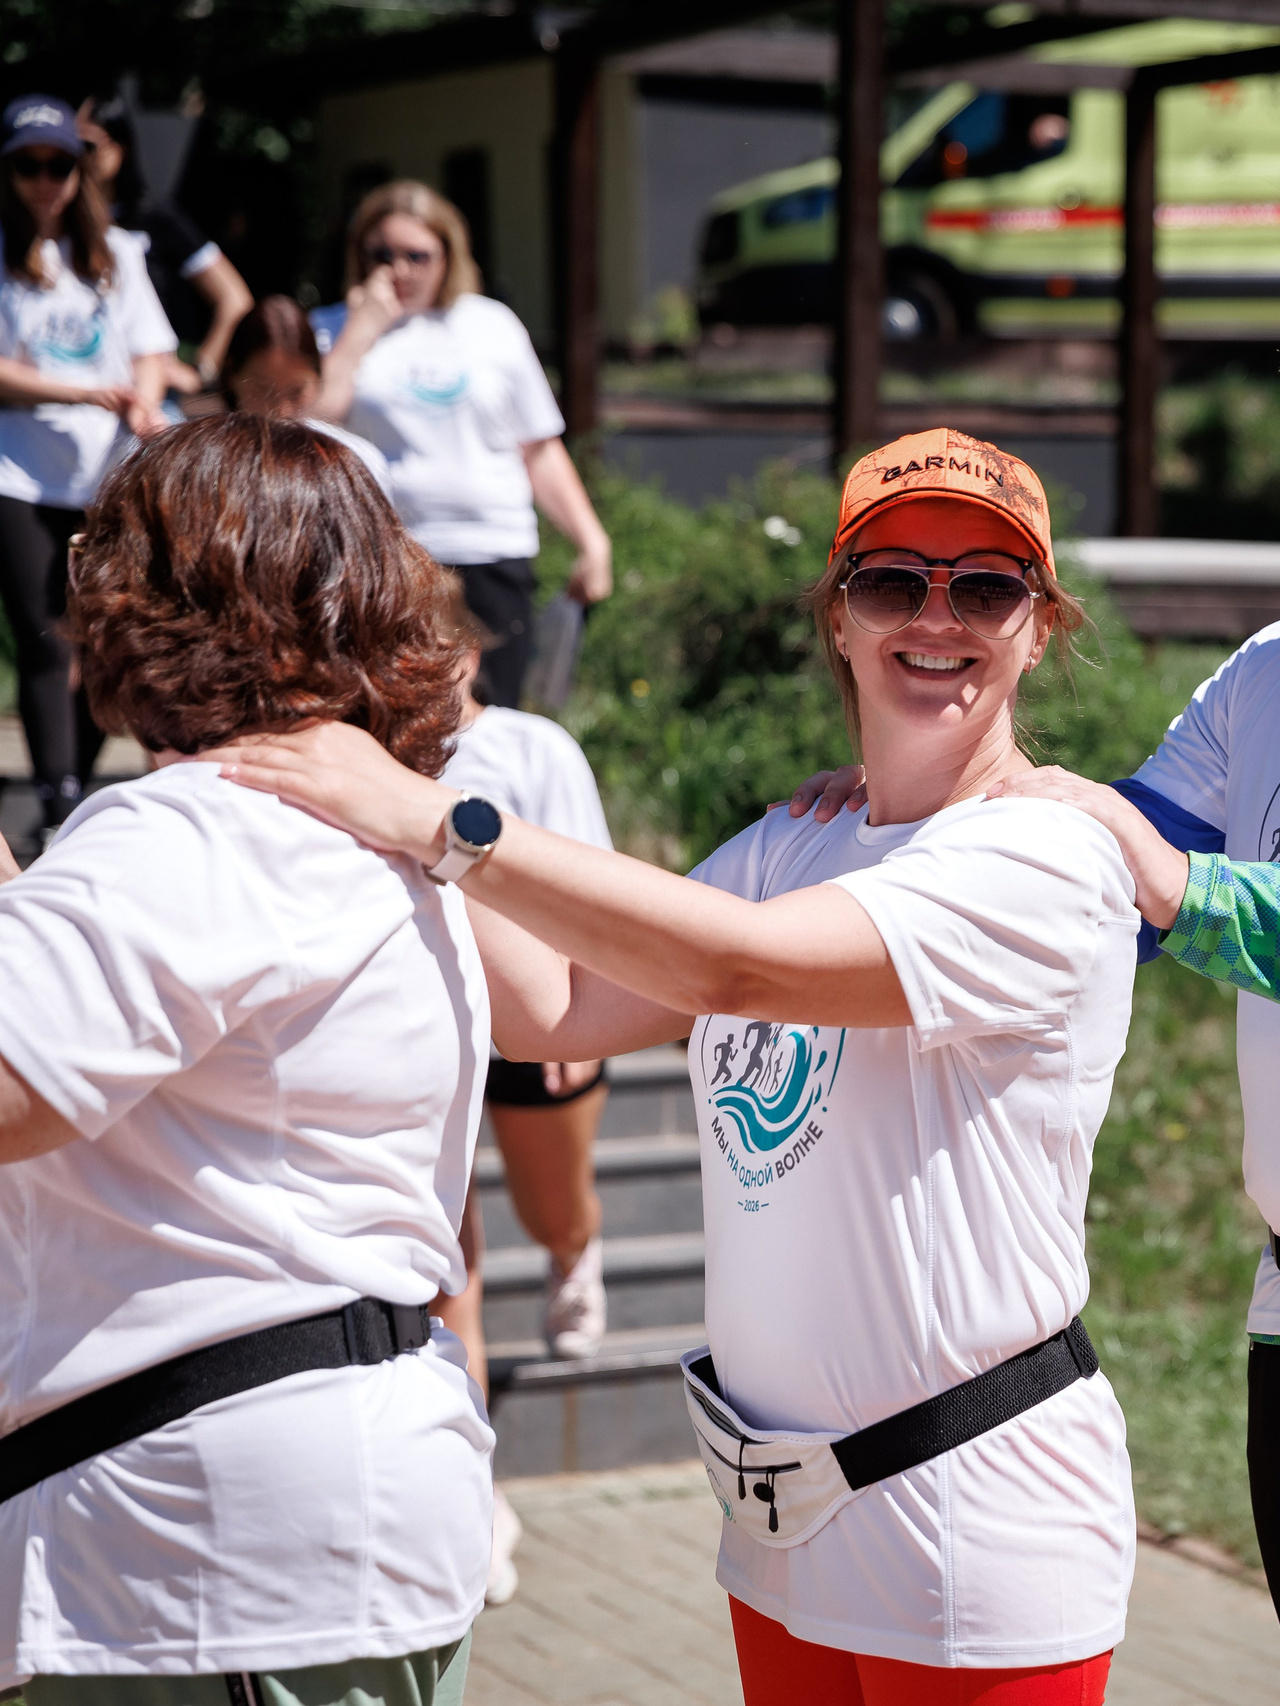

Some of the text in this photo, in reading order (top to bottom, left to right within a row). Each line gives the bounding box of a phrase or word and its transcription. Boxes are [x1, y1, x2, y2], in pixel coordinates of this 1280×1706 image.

[882, 455, 1004, 488] GARMIN
[711, 1116, 824, 1190] МЫ НА ОДНОЙ ВОЛНЕ
[743, 1199, 760, 1212] 2026
